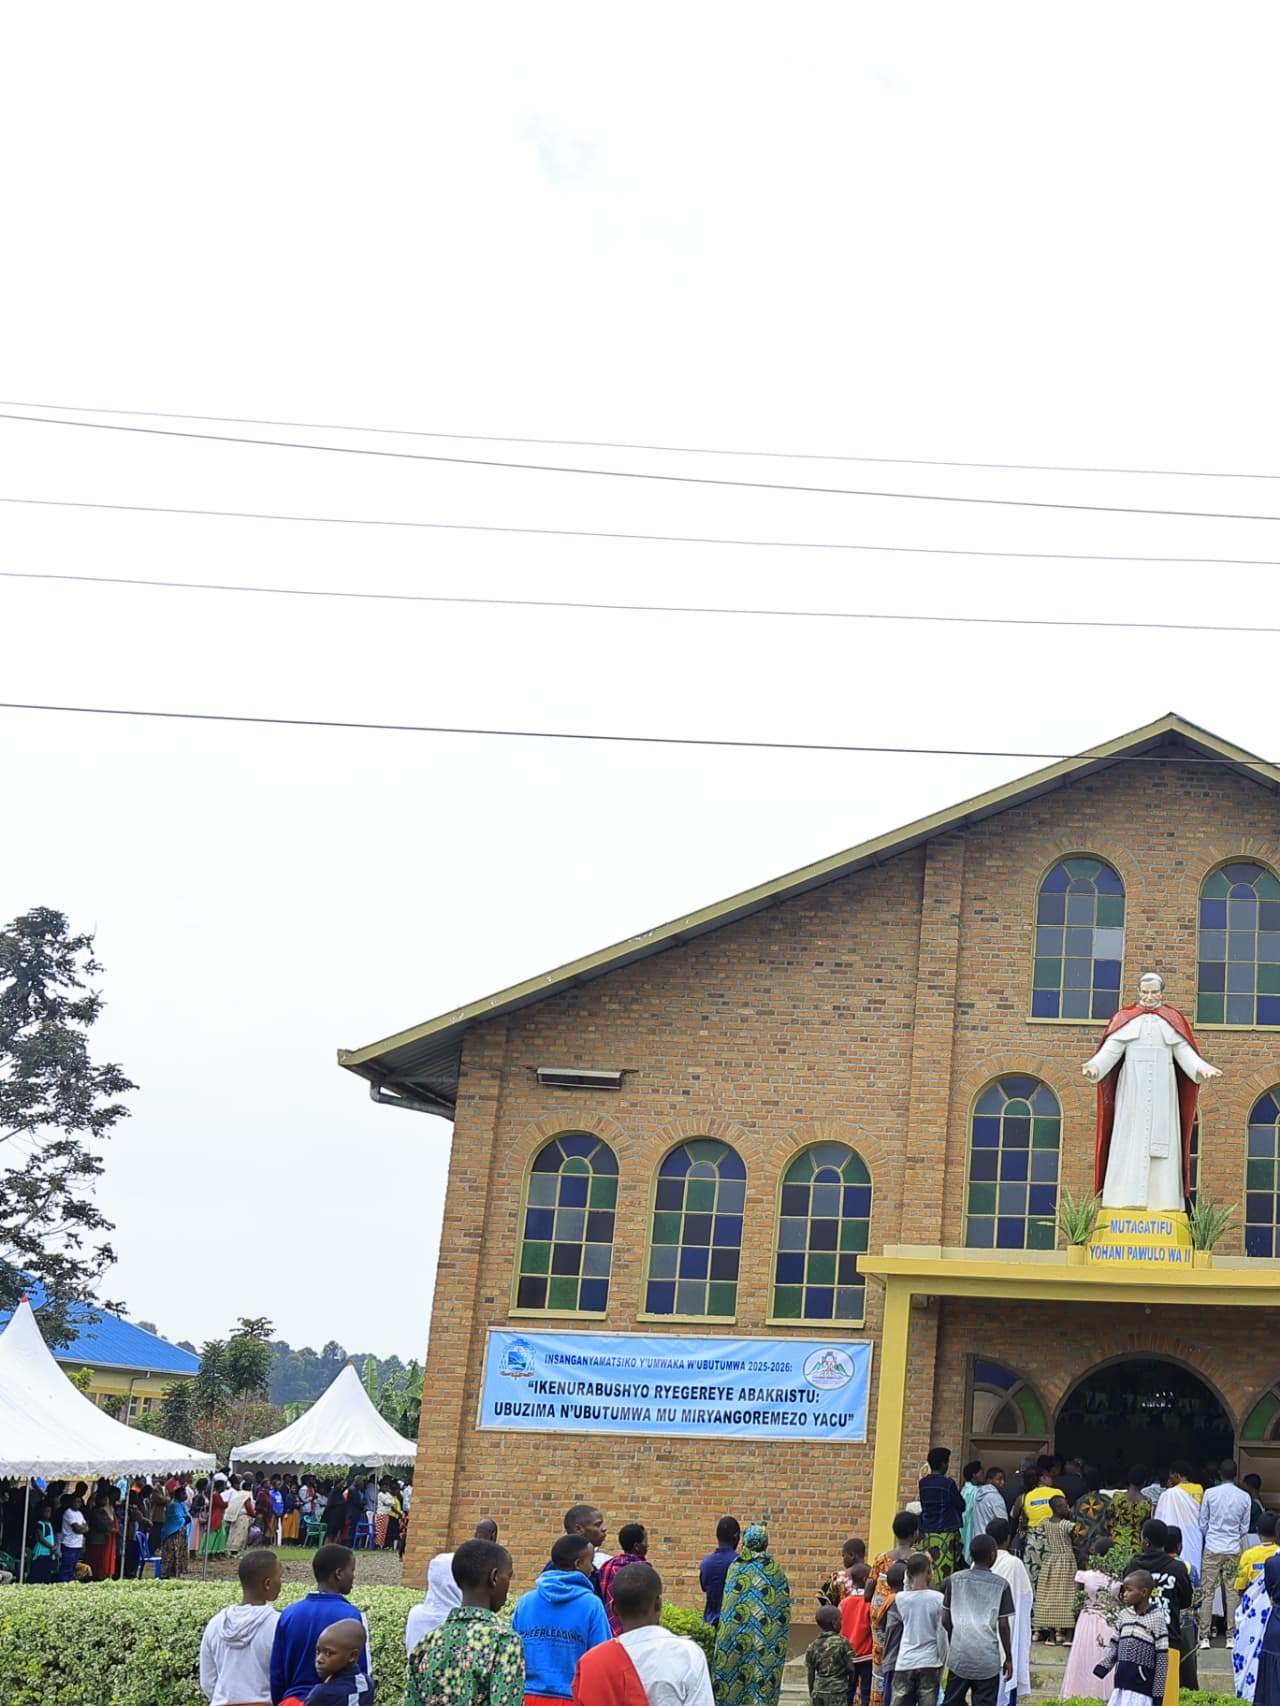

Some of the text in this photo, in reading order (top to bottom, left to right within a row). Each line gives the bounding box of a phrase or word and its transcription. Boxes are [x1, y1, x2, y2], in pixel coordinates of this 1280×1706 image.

[1110, 1219, 1172, 1235] MUTAGATIFU
[1090, 1245, 1191, 1262] YOHANI PAWULO WA II
[545, 1353, 793, 1373] INSANGANYAMATSIKO Y'UMWAKA W'UBUTUMWA 2025-2026:
[528, 1380, 820, 1403] “IKENURABUSHYO RYEGEREYE ABAKRISTU:
[494, 1401, 854, 1427] UBUZIMA N'UBUTUMWA MU MIRYANGOREMEZO YACU”
